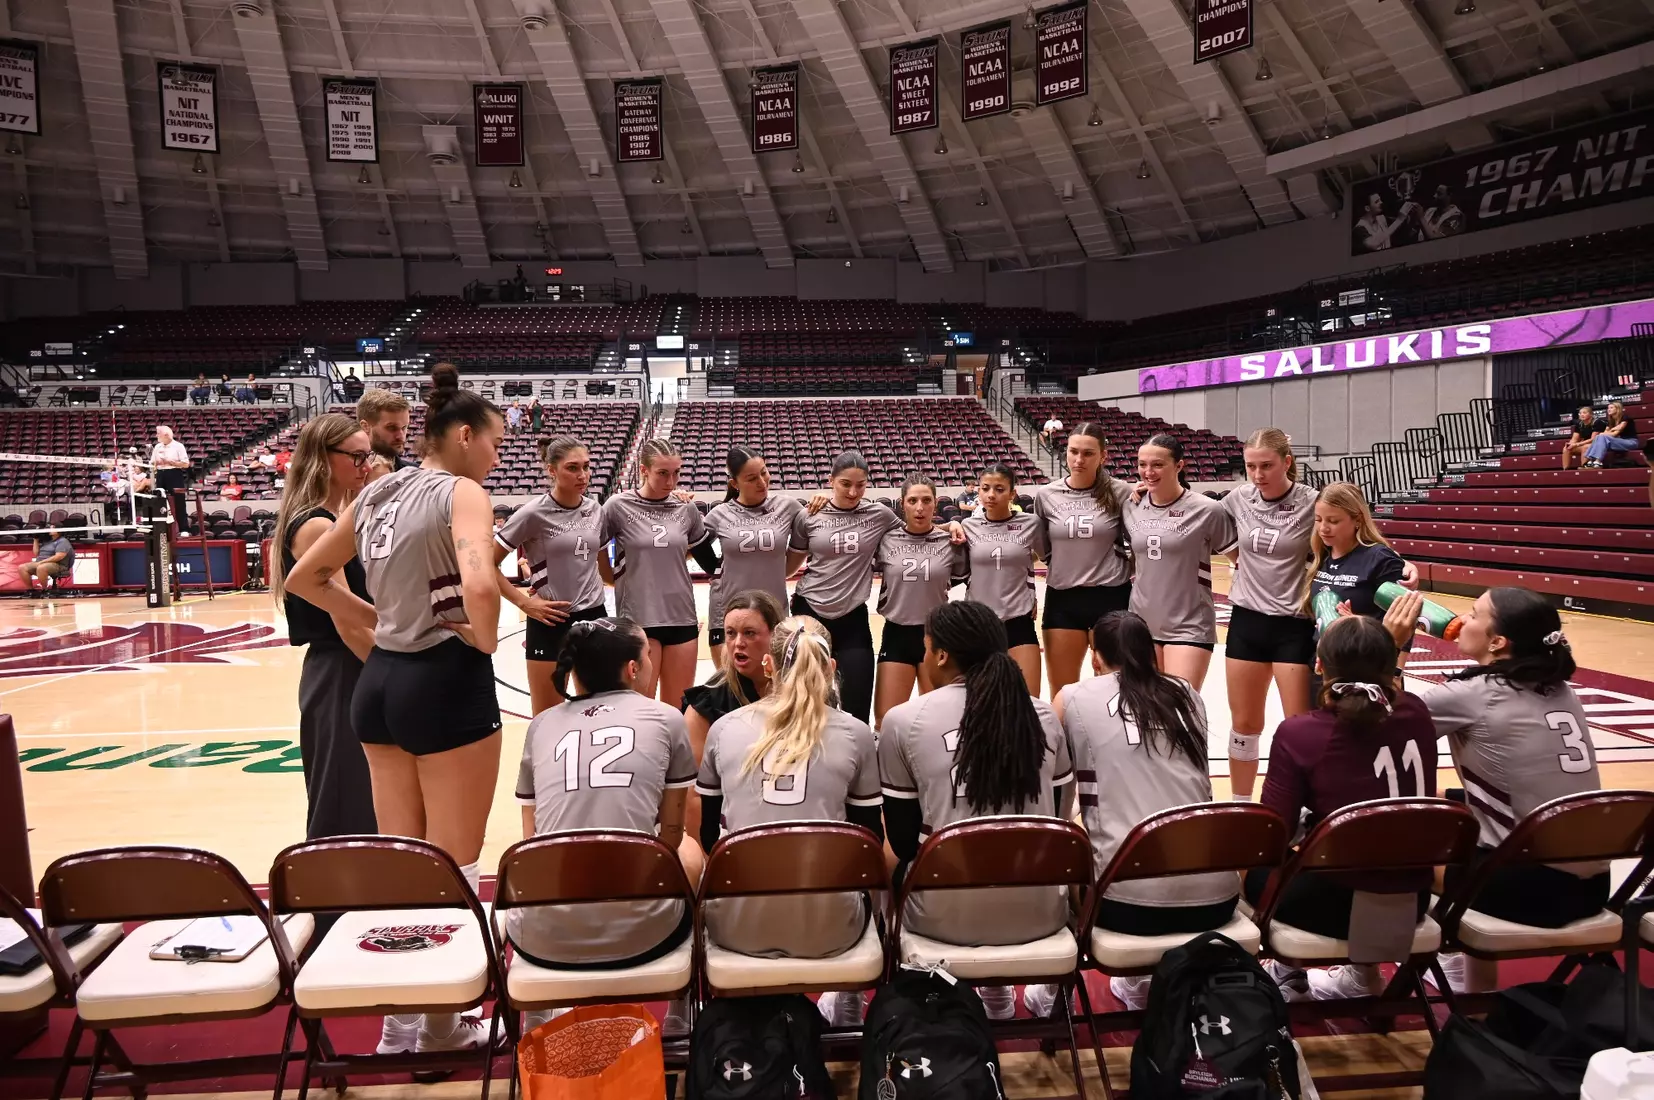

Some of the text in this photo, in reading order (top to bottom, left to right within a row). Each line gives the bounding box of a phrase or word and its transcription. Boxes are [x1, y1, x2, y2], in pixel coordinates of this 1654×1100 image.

[1198, 0, 1247, 23] CHAMPIONS
[1039, 25, 1083, 41] BASKETBALL
[1045, 21, 1077, 34] WOMEN'S
[1200, 26, 1246, 52] 2007
[964, 45, 1005, 60] BASKETBALL
[970, 41, 1001, 53] WOMEN'S
[1043, 38, 1079, 59] NCAA
[893, 62, 934, 75] BASKETBALL
[899, 58, 929, 68] WOMEN'S
[969, 58, 1003, 77] NCAA
[1041, 52, 1083, 70] TOURNAMENT
[897, 75, 931, 92] NCAA
[966, 71, 1005, 87] TOURNAMENT
[1043, 77, 1080, 96] 1992
[0, 88, 34, 100] MPIONS
[164, 84, 211, 94] BASKETBALL
[755, 87, 794, 96] BASKETBALL
[902, 90, 926, 100] SWEET
[178, 97, 199, 110] NIT
[486, 94, 516, 103] ALUKI
[759, 98, 791, 112] NCAA
[899, 99, 930, 110] SIXTEEN
[969, 95, 1004, 112] 1990
[0, 113, 29, 125] 977
[169, 110, 210, 120] NATIONAL
[341, 110, 360, 122] NIT
[483, 114, 514, 124] WNIT
[621, 116, 657, 124] CONFERENCE
[757, 111, 793, 121] TOURNAMENT
[898, 111, 931, 125] 1987
[166, 119, 214, 130] CHAMPIONS
[620, 124, 658, 133] CHAMPIONS
[170, 132, 210, 145] 1967
[629, 141, 650, 149] 1987
[759, 132, 791, 144] 1986
[1464, 124, 1647, 188] 1967 NIT
[1239, 324, 1492, 383] SALUKIS
[354, 499, 401, 563] 13
[1064, 514, 1095, 539] 15
[651, 523, 669, 548] 2
[738, 529, 775, 553] 20
[829, 531, 860, 555] 18
[1249, 527, 1280, 554] 17
[574, 536, 590, 561] 4
[1146, 535, 1162, 560] 8
[991, 547, 1002, 571] 1
[902, 557, 932, 583] 21
[1544, 711, 1592, 774] 3
[554, 725, 635, 793] 12
[1373, 739, 1426, 799] 11
